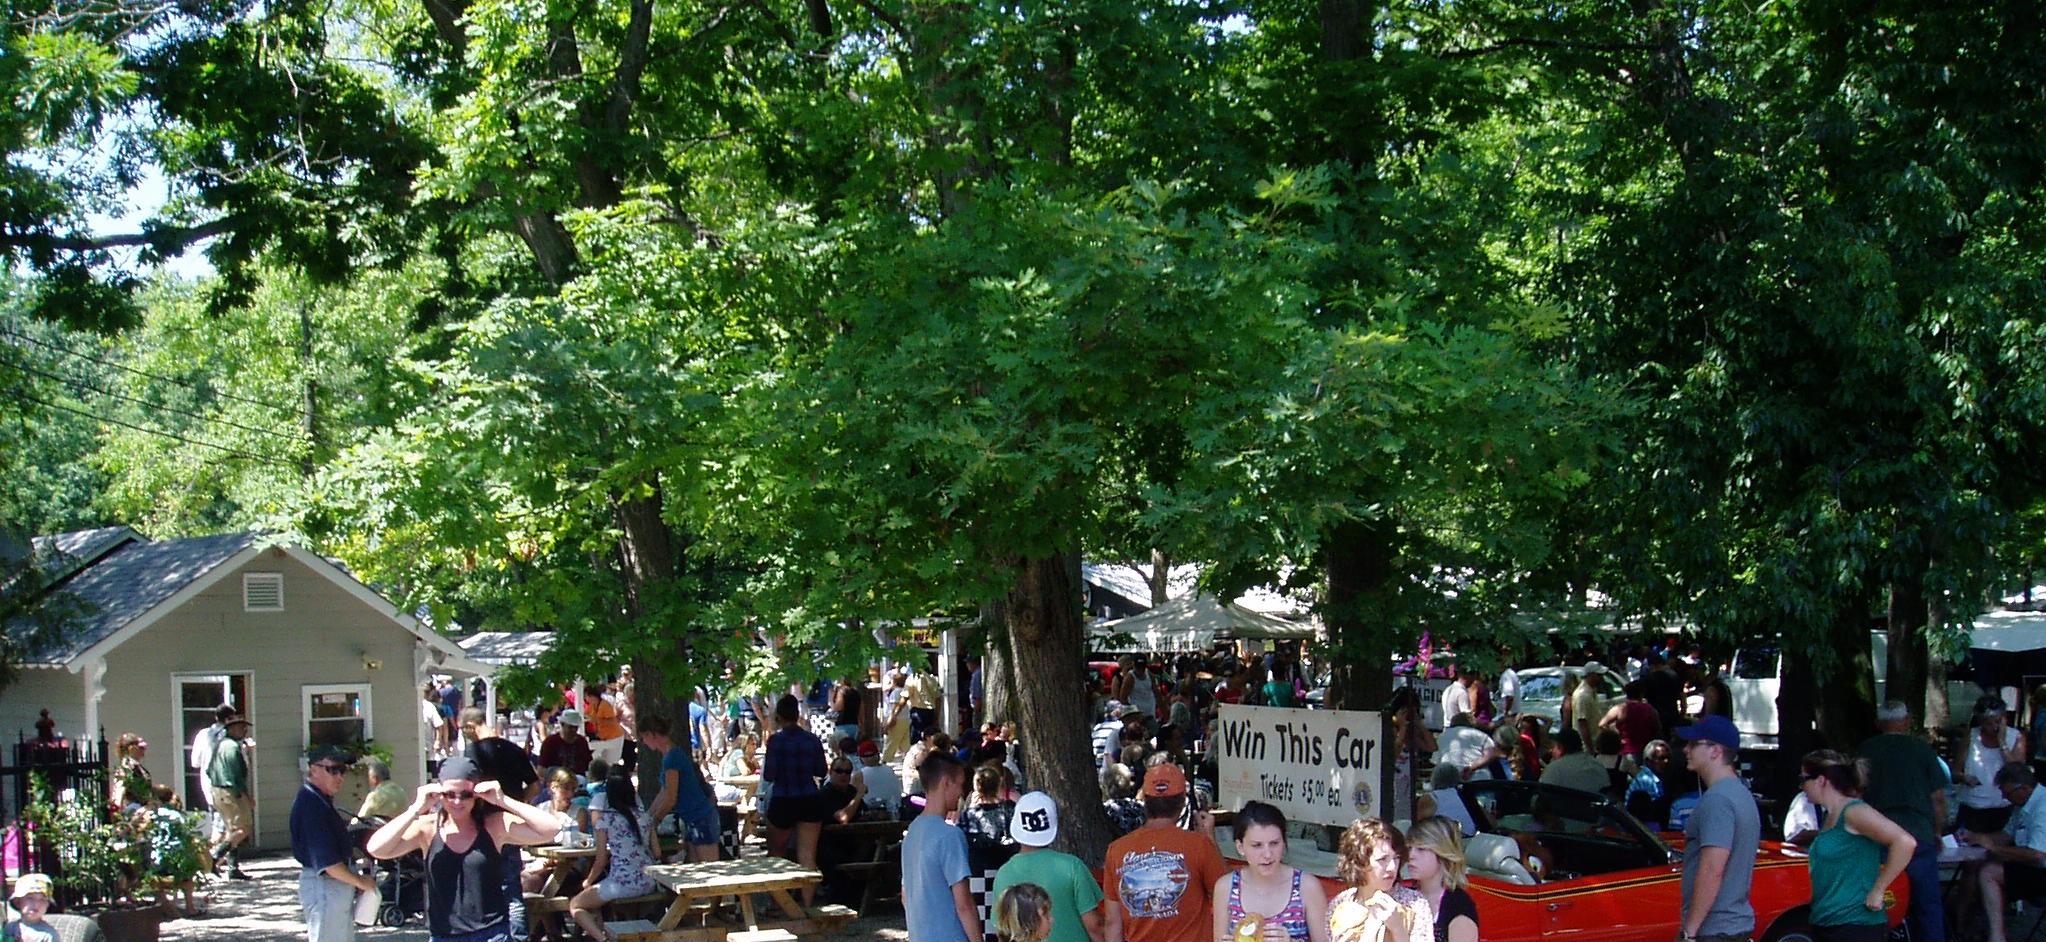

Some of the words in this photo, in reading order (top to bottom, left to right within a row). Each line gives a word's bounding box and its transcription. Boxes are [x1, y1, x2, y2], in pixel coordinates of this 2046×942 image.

[1223, 719, 1266, 760] Win
[1275, 721, 1323, 766] This
[1334, 727, 1375, 770] Car
[1260, 772, 1294, 802] Tickets
[1327, 786, 1342, 807] ea.
